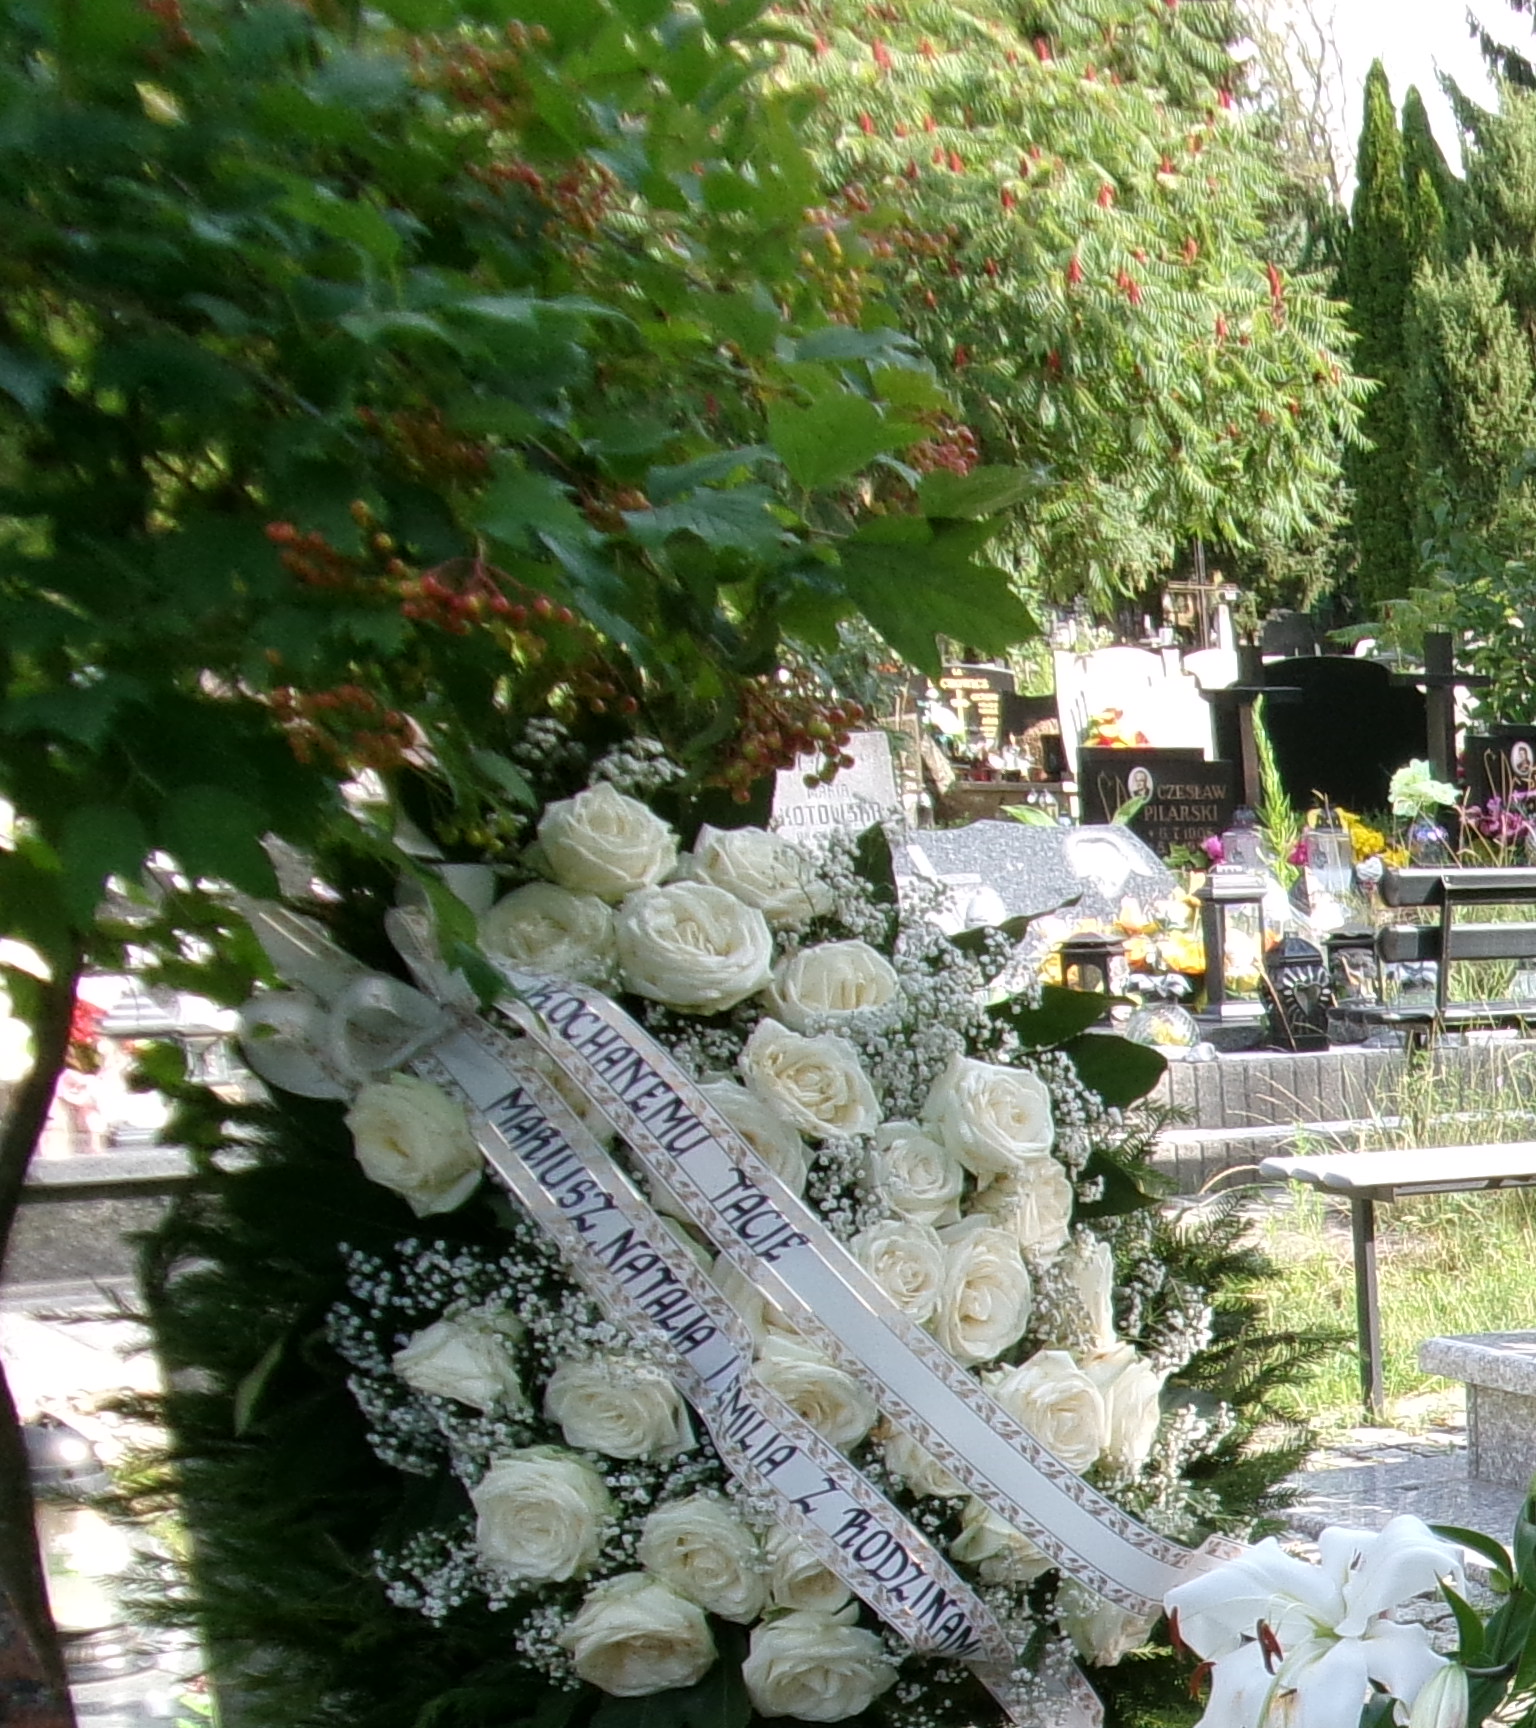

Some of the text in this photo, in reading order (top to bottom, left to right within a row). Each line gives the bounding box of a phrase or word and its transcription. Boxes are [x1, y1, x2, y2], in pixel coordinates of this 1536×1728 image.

[1157, 783, 1227, 801] CZESŁAW
[1143, 804, 1219, 822] PILARSKI
[710, 1166, 808, 1264] TACIE
[791, 1475, 838, 1515] Z
